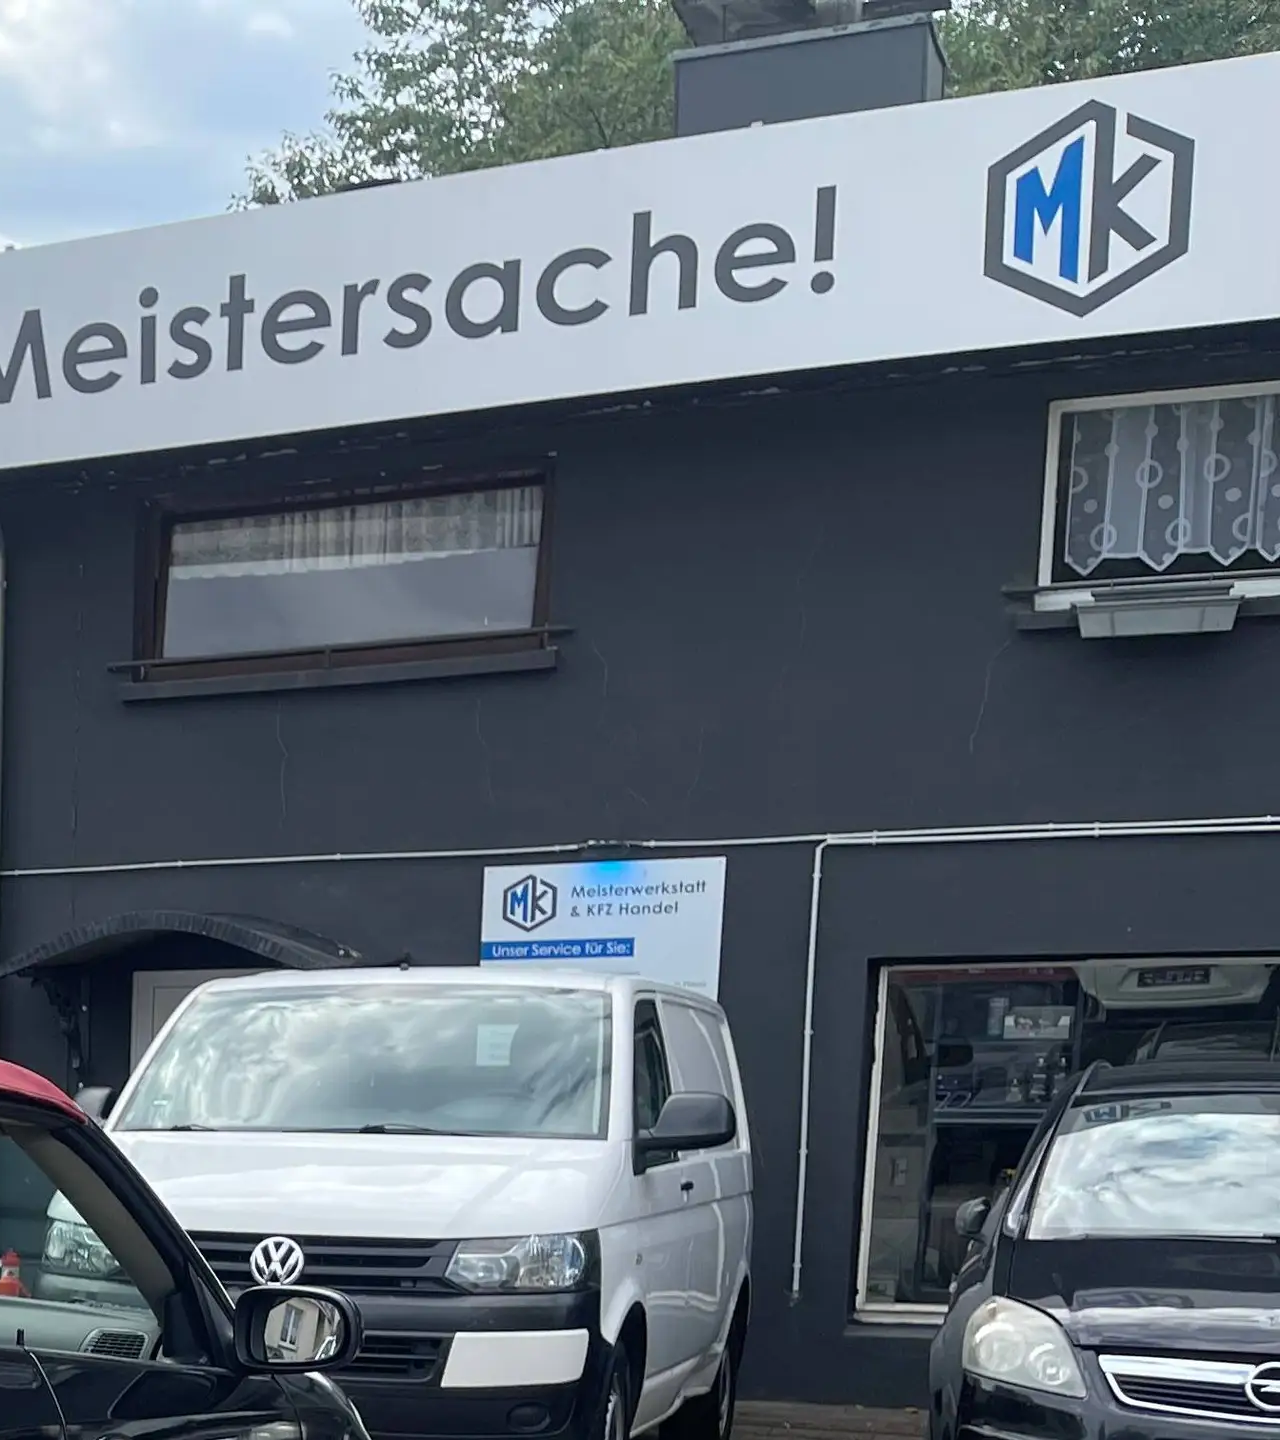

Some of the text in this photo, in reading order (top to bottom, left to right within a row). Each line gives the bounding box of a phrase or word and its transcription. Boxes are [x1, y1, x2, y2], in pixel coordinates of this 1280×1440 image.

[571, 880, 707, 899] Meisterwerkstatt
[571, 900, 679, 918] & KFZ Handel
[492, 940, 632, 957] Unser Service für Sie:
